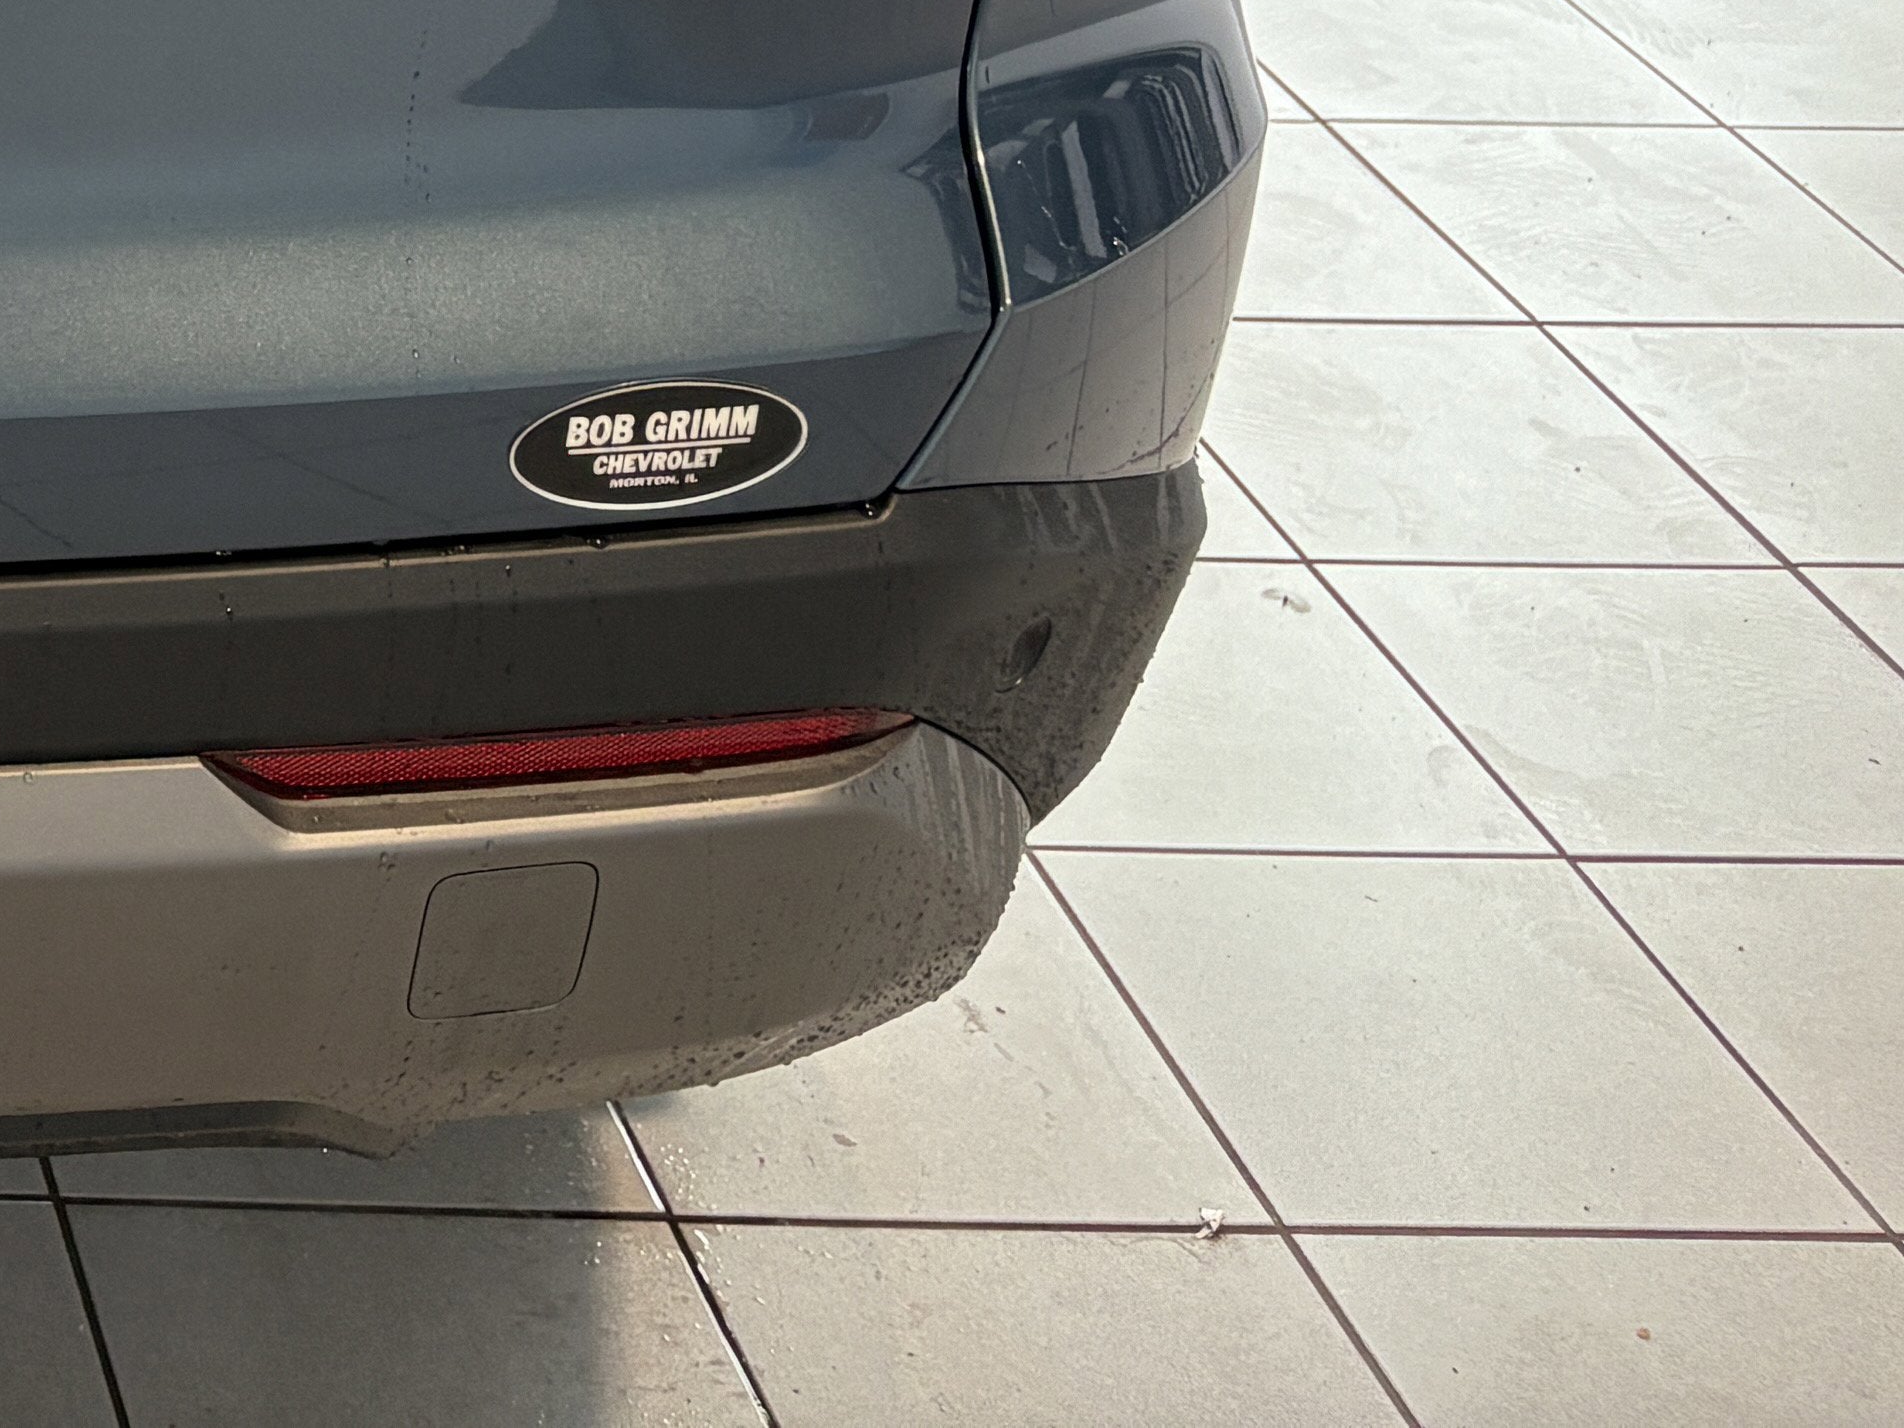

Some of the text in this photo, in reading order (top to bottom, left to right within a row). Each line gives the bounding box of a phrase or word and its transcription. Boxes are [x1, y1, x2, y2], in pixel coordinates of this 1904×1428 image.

[564, 403, 761, 448] BOB GRIMM
[592, 447, 723, 476] CHEVROLET
